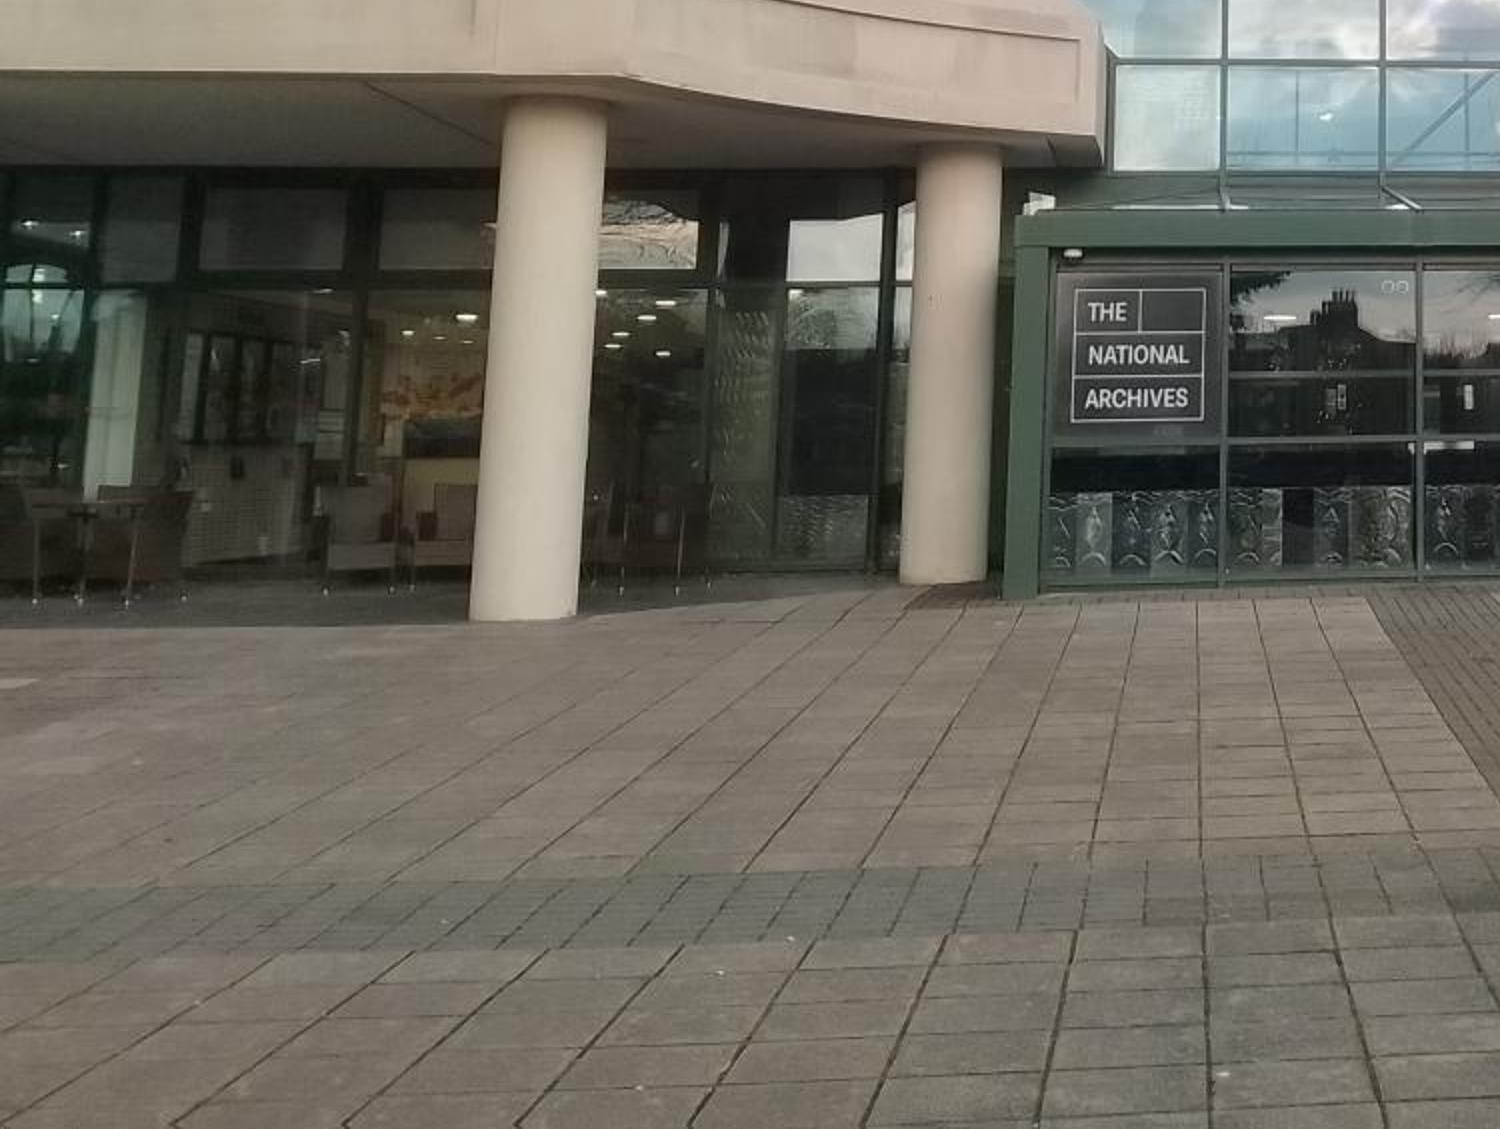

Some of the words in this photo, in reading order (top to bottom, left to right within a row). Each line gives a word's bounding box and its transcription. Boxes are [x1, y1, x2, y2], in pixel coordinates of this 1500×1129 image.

[1087, 302, 1128, 322] THE
[1088, 344, 1190, 365] NATIONAL
[1084, 388, 1189, 409] ARCHIVES
